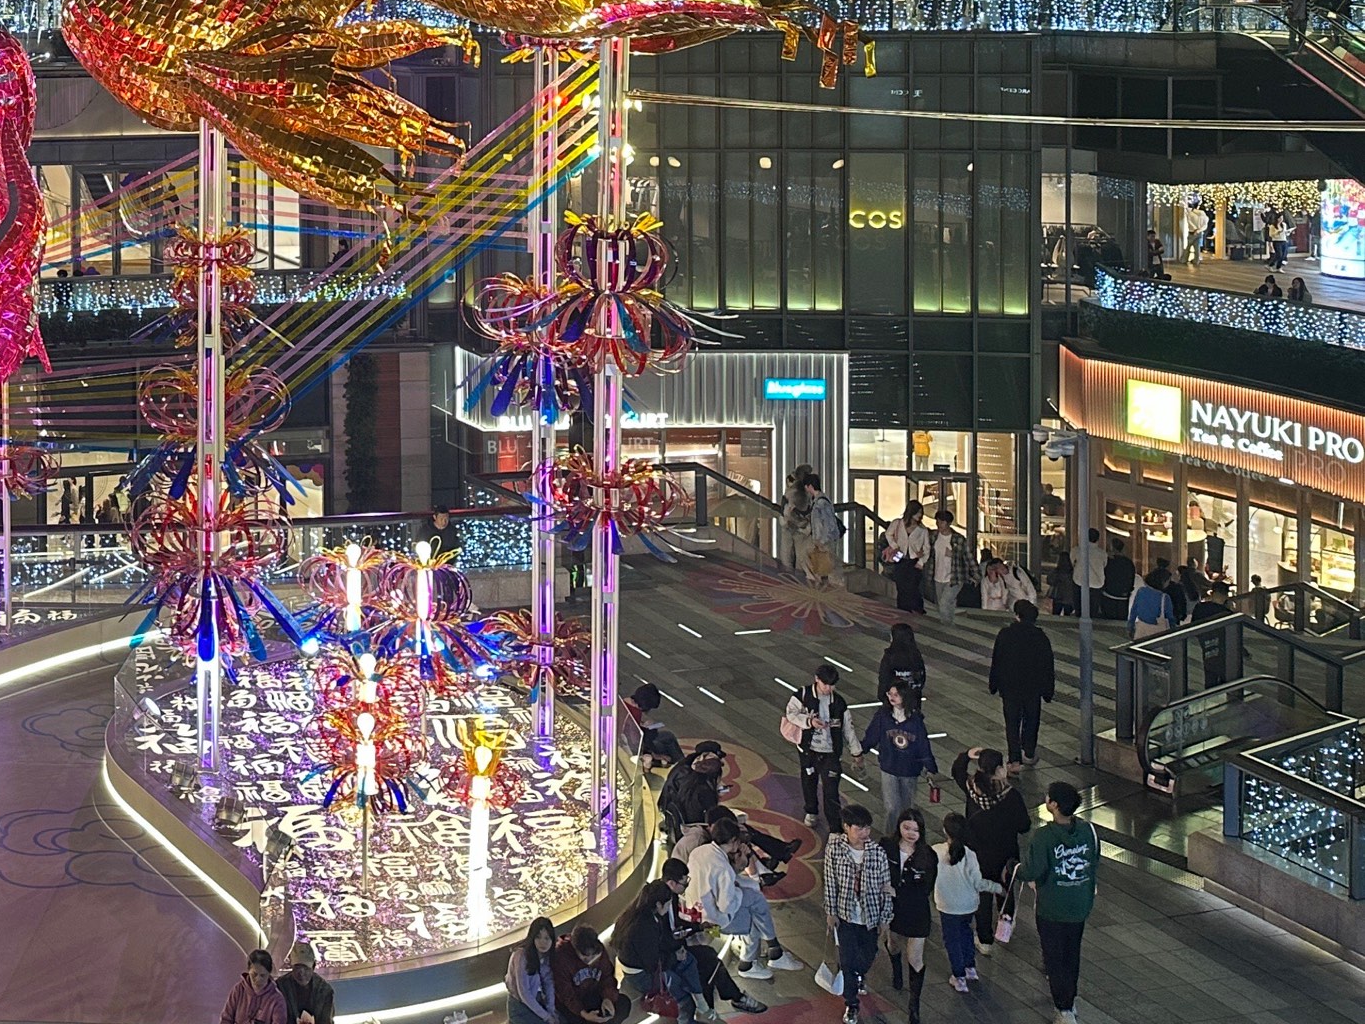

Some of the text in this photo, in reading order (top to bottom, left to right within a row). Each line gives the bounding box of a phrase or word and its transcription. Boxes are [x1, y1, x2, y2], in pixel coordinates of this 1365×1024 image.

[849, 210, 902, 229] COS
[1190, 426, 1284, 461] Tea & Coffee
[1191, 399, 1302, 447] NAYUKI
[1308, 426, 1365, 464] PRO
